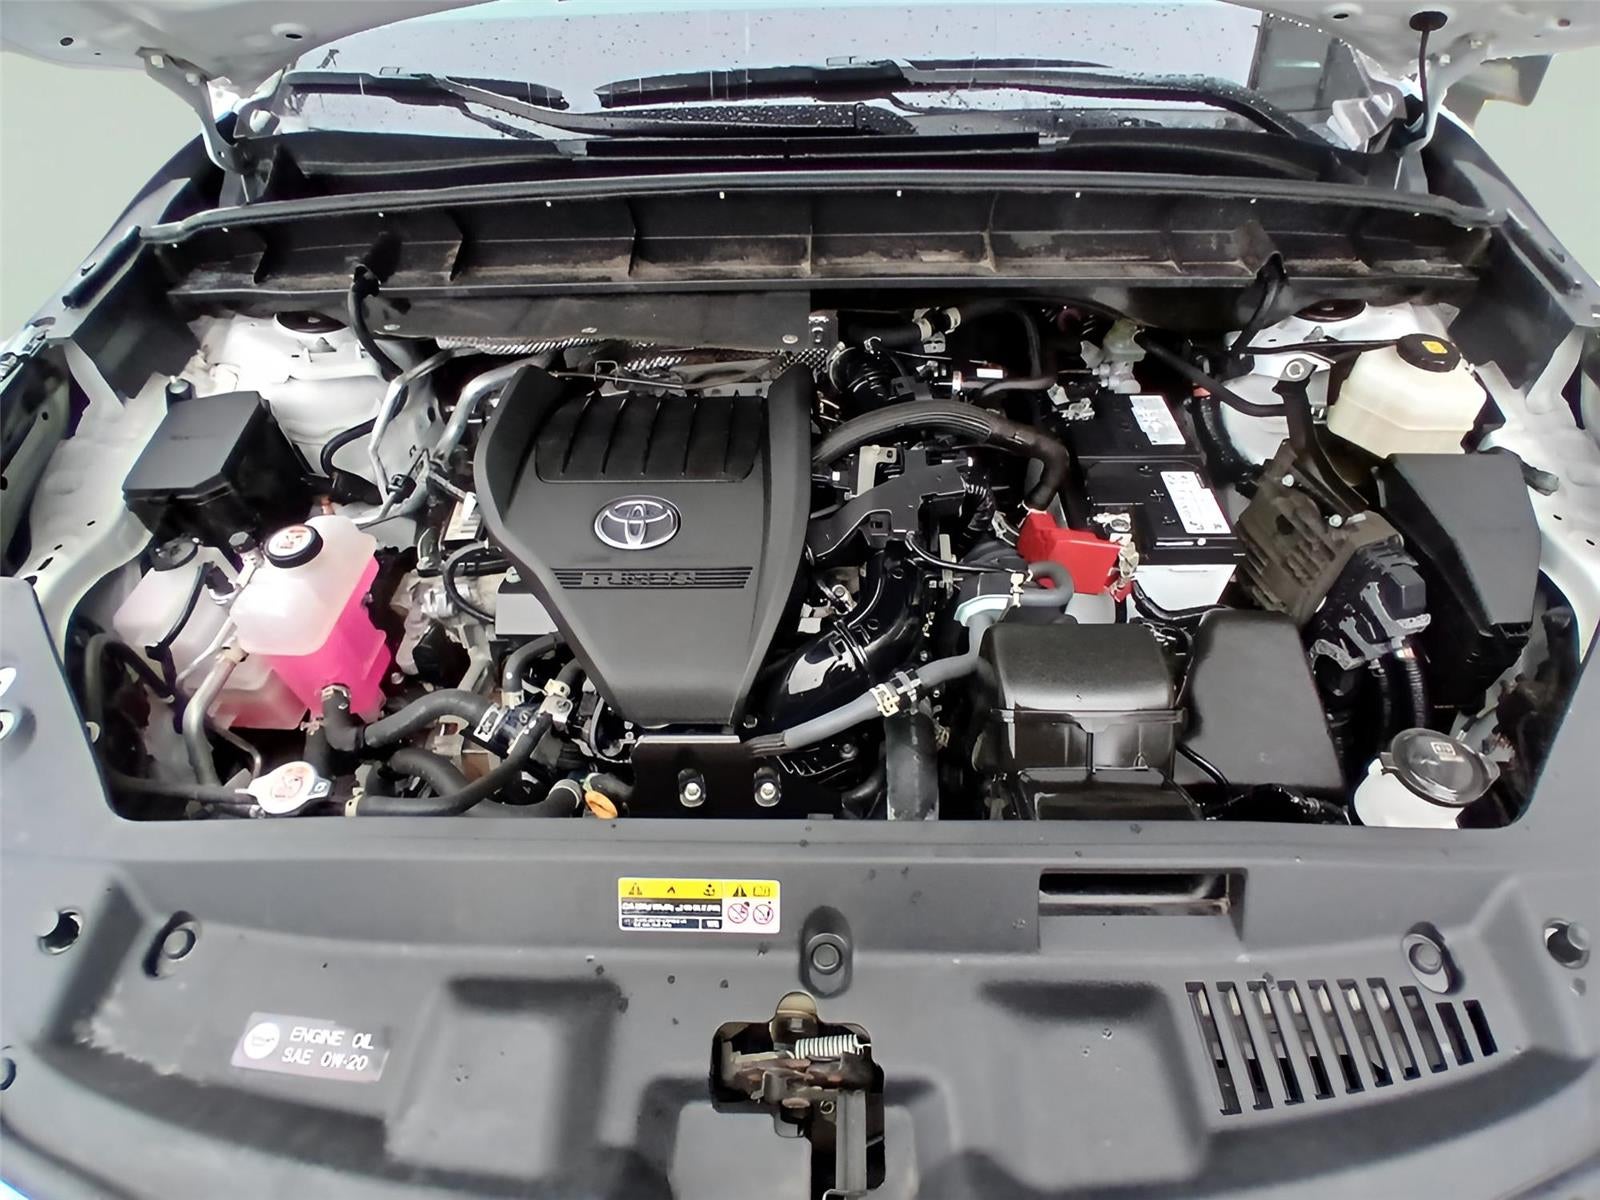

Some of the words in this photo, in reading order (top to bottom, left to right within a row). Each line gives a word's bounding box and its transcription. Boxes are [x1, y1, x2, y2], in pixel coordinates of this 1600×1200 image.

[290, 1027, 345, 1046] ENGINE
[352, 1033, 374, 1050] OIL
[282, 1047, 314, 1065] SAE
